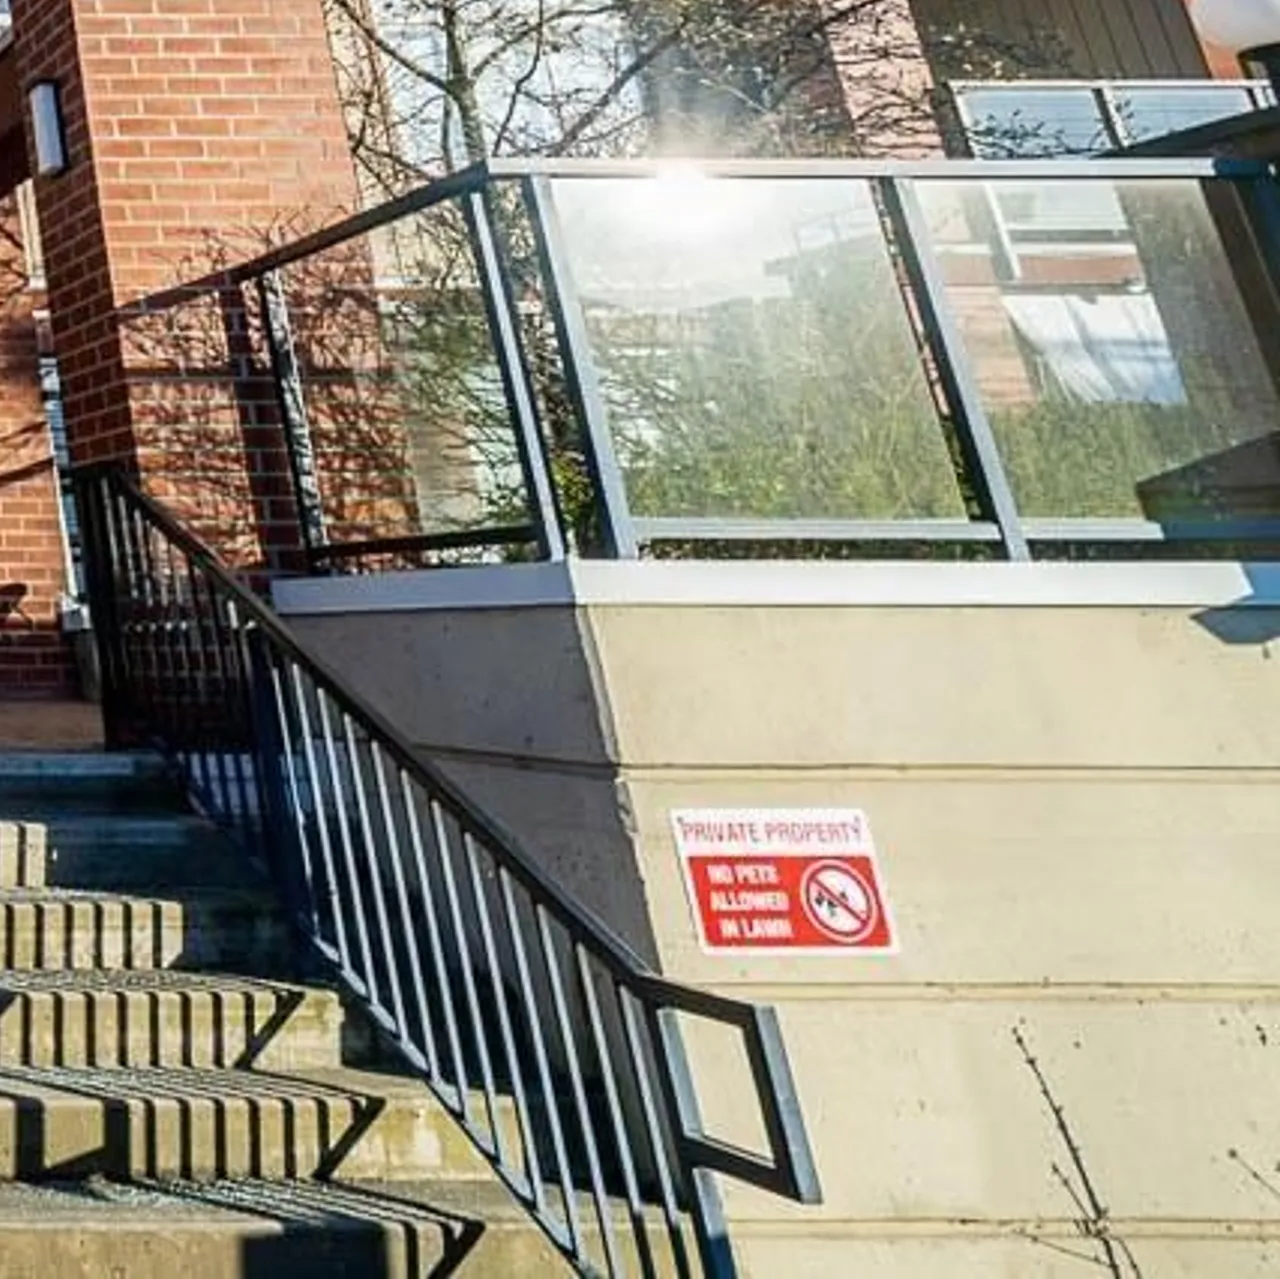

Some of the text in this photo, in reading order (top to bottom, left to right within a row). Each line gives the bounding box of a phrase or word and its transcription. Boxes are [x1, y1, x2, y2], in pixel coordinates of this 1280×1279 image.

[682, 821, 861, 843] PRIVATE PROPERTY
[706, 864, 780, 884] NO PETS
[710, 890, 790, 911] ALLOWED
[718, 918, 794, 938] IN LAWN
